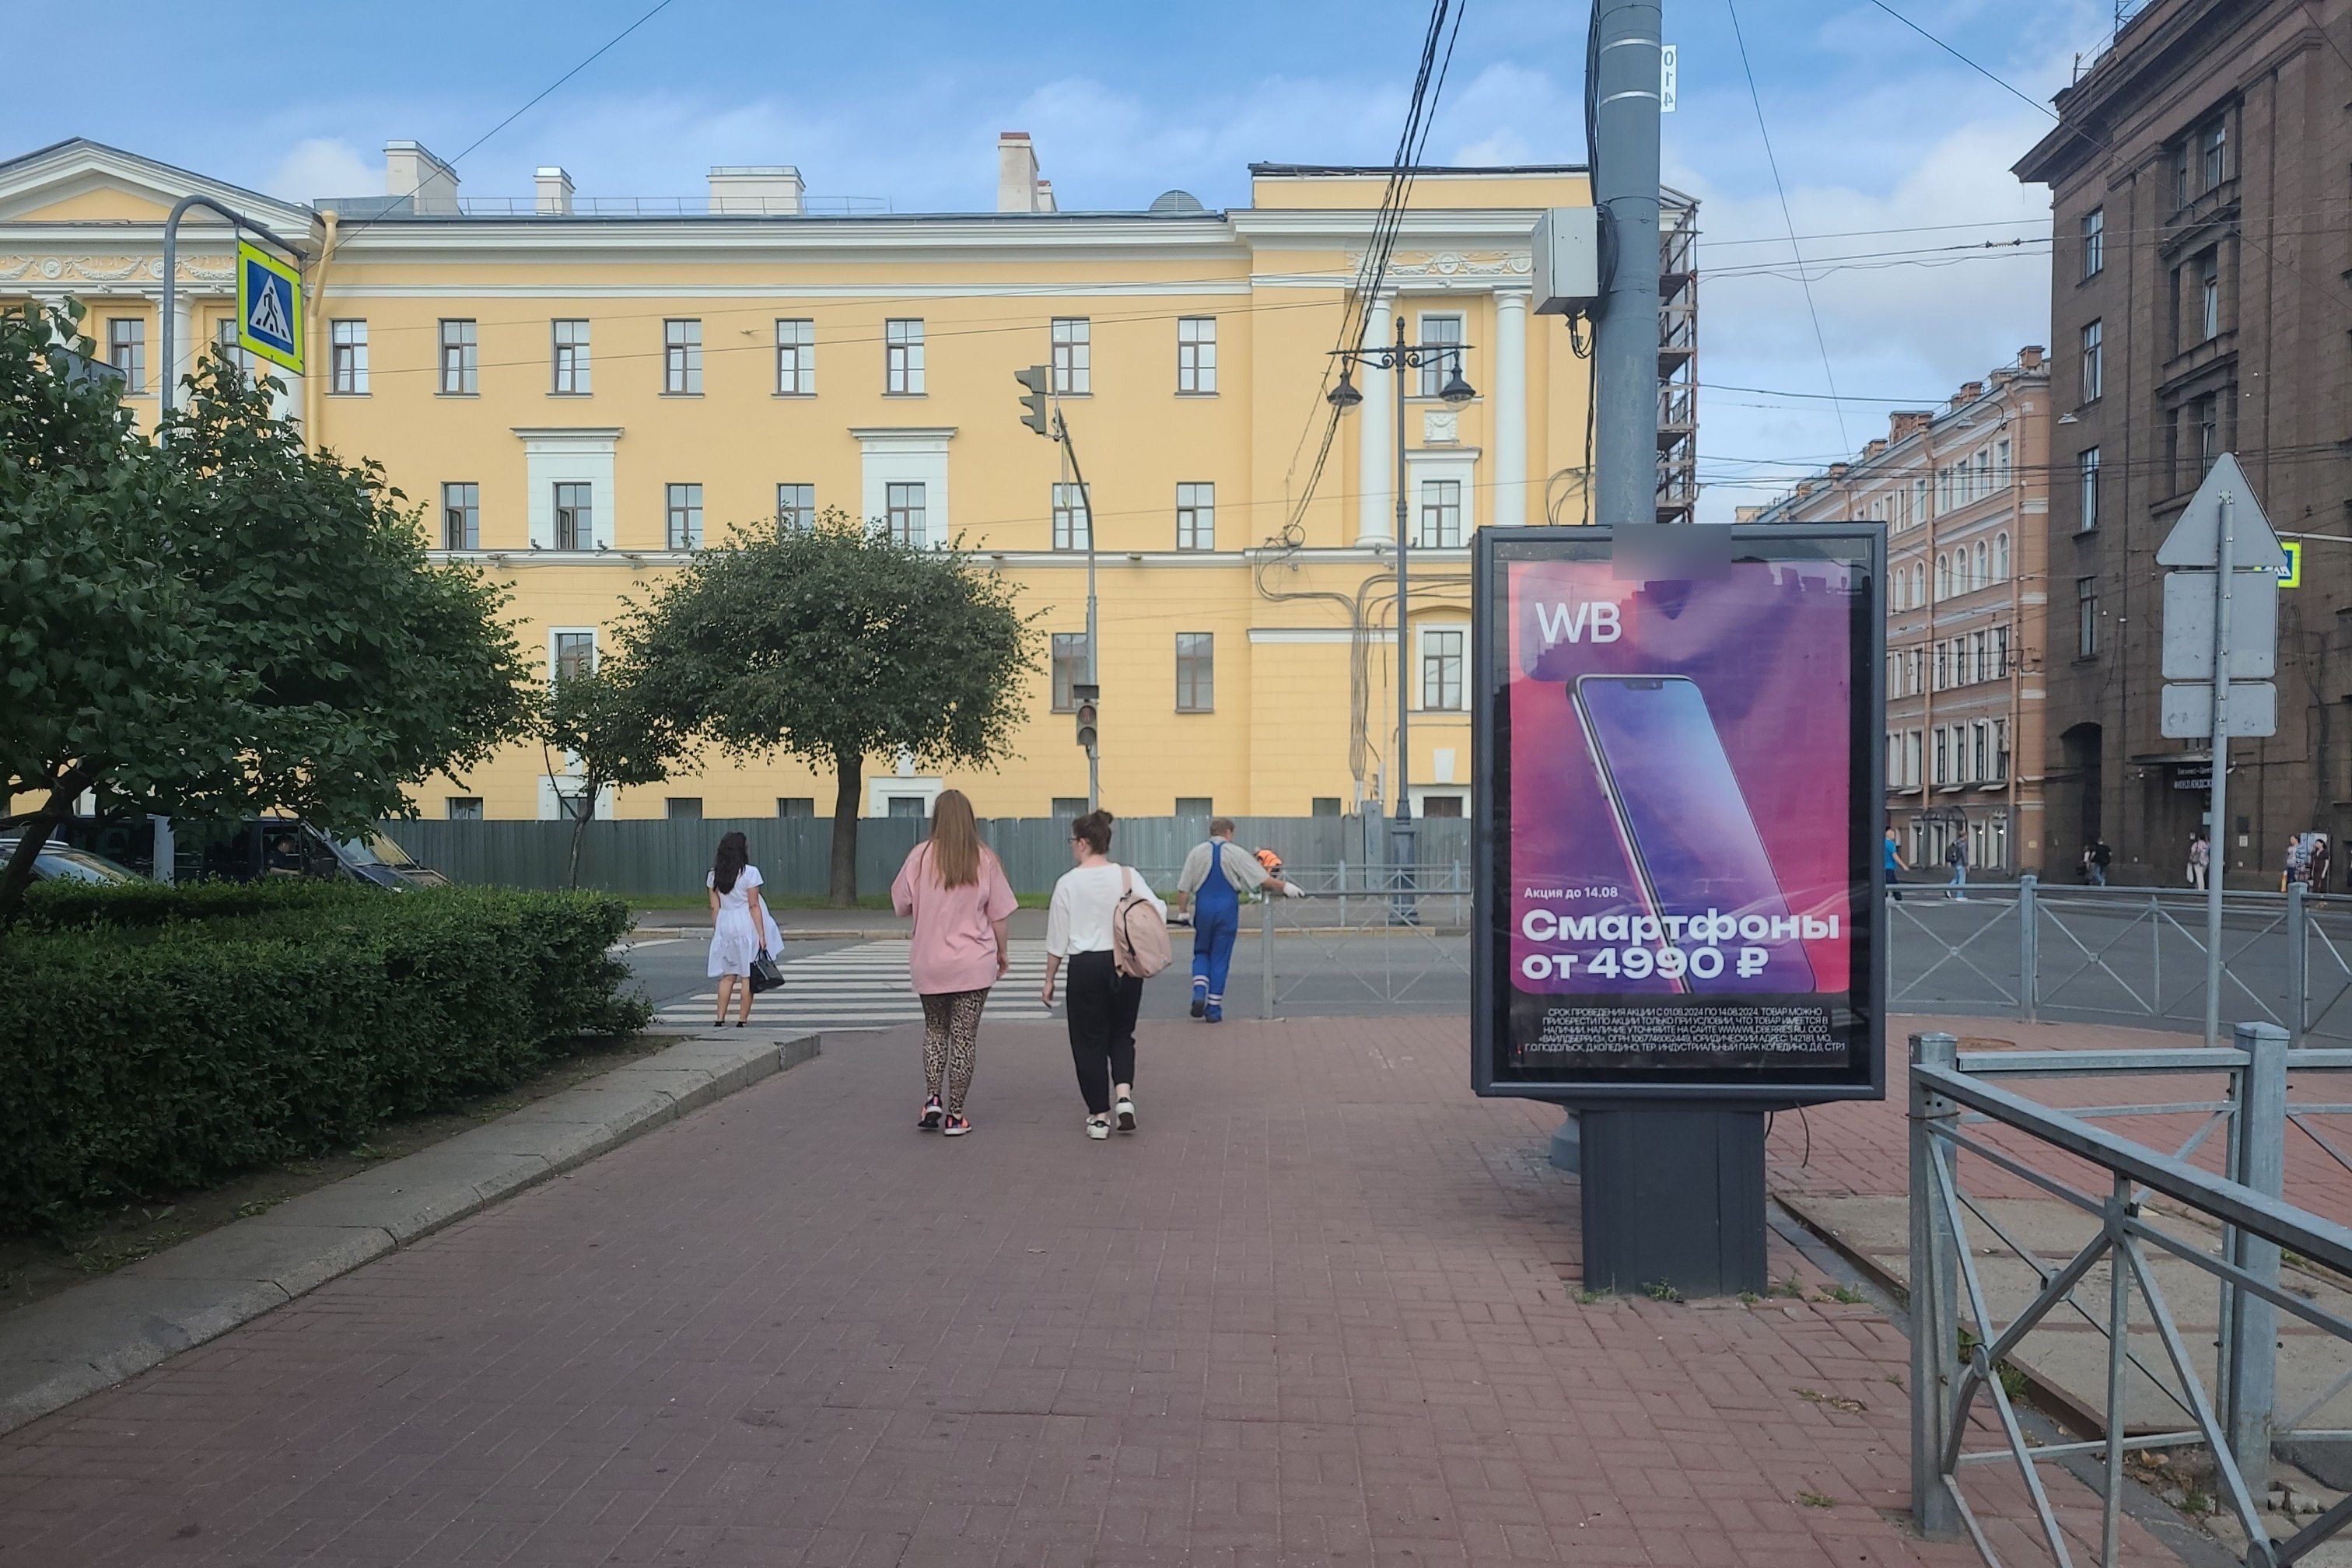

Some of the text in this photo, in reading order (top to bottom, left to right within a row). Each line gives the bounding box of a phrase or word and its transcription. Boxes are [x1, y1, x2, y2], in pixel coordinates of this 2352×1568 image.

[1535, 601, 1622, 644] WB
[2174, 779, 2213, 789] ФИНЛЯНДСК
[1524, 887, 1619, 900] Акция до 14.08
[1521, 908, 1840, 946] Смартфоны
[1521, 954, 1579, 980] от
[1587, 947, 1725, 980] 4990
[1548, 1007, 1570, 1017] СРОК
[1571, 1007, 1626, 1017] ПРОВЕДЕНИЯ
[1626, 1007, 1655, 1017] АКЦИИ
[1656, 1007, 1663, 1017] С
[1704, 1007, 1717, 1017] ПО
[1761, 1007, 1787, 1017] ТОВАР
[1789, 1007, 1822, 1017] МОЖНО
[1542, 1017, 1597, 1025] ПРИОБРЕСТИ
[1598, 1017, 1611, 1025] ПО
[1611, 1017, 1640, 1025] АКЦИИ
[1642, 1017, 1674, 1025] ТОЛЬКО
[1675, 1017, 1692, 1025] ПРИ
[1735, 1017, 1753, 1025] ЧТО
[1754, 1017, 1781, 1025] ТОВАР
[1782, 1017, 1821, 1025] ИМЕЕТСЯ
[1822, 1017, 1828, 1025] В
[1808, 1025, 1828, 1034] ООО
[1608, 1034, 1629, 1043] ОГРН
[1692, 1034, 1758, 1043] ЮРИДИЧЕСКИЙ
[1658, 1043, 1738, 1052] ИНДУСТРИАЛЬНЫЙ
[1739, 1043, 1760, 1052] ПАРК
